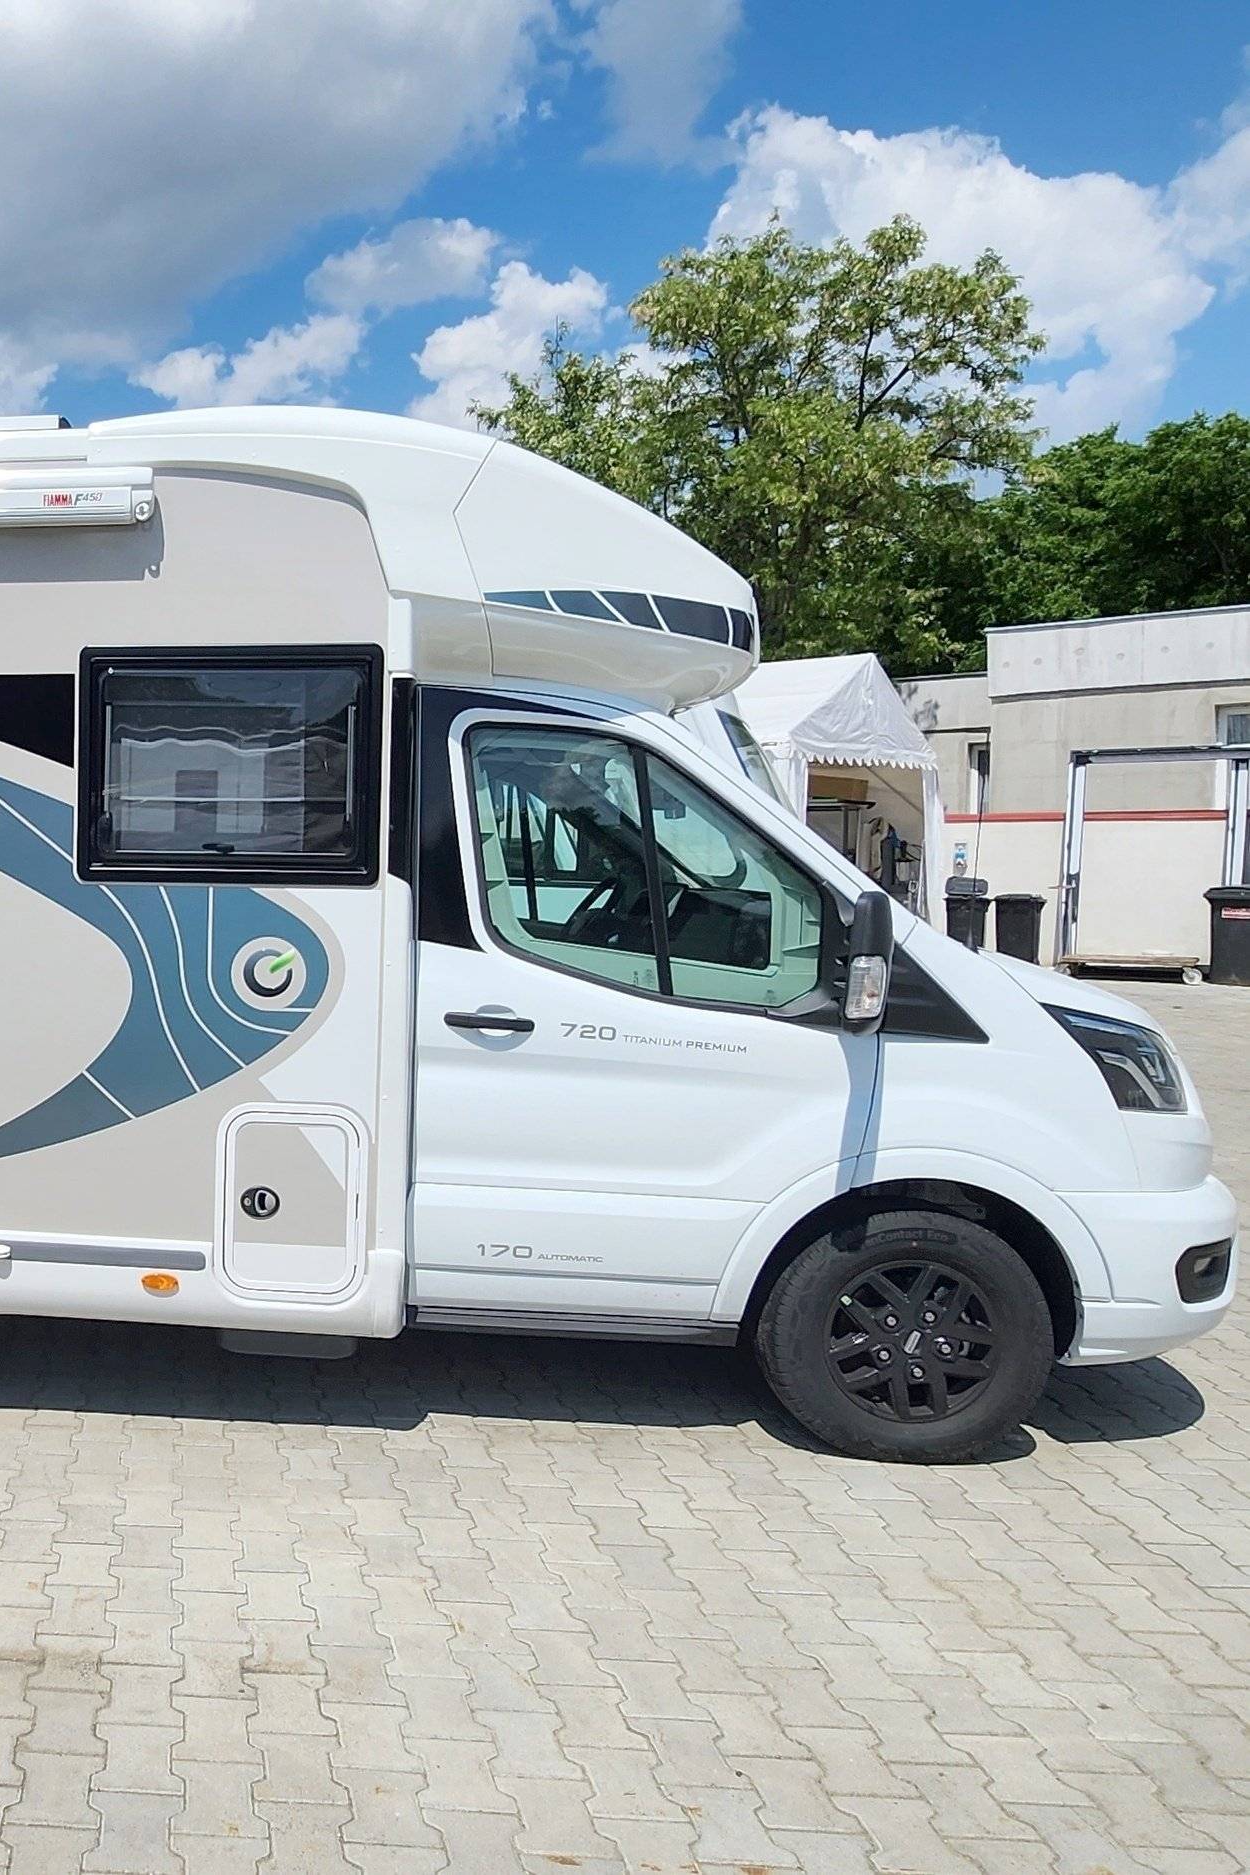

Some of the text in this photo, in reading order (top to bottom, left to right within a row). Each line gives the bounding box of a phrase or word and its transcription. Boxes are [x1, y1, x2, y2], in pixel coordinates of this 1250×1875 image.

[43, 493, 73, 507] FIAMMA
[560, 1022, 748, 1054] 720 TITANIUM PREMIUM
[476, 1243, 604, 1263] 170 AUTOMATIC
